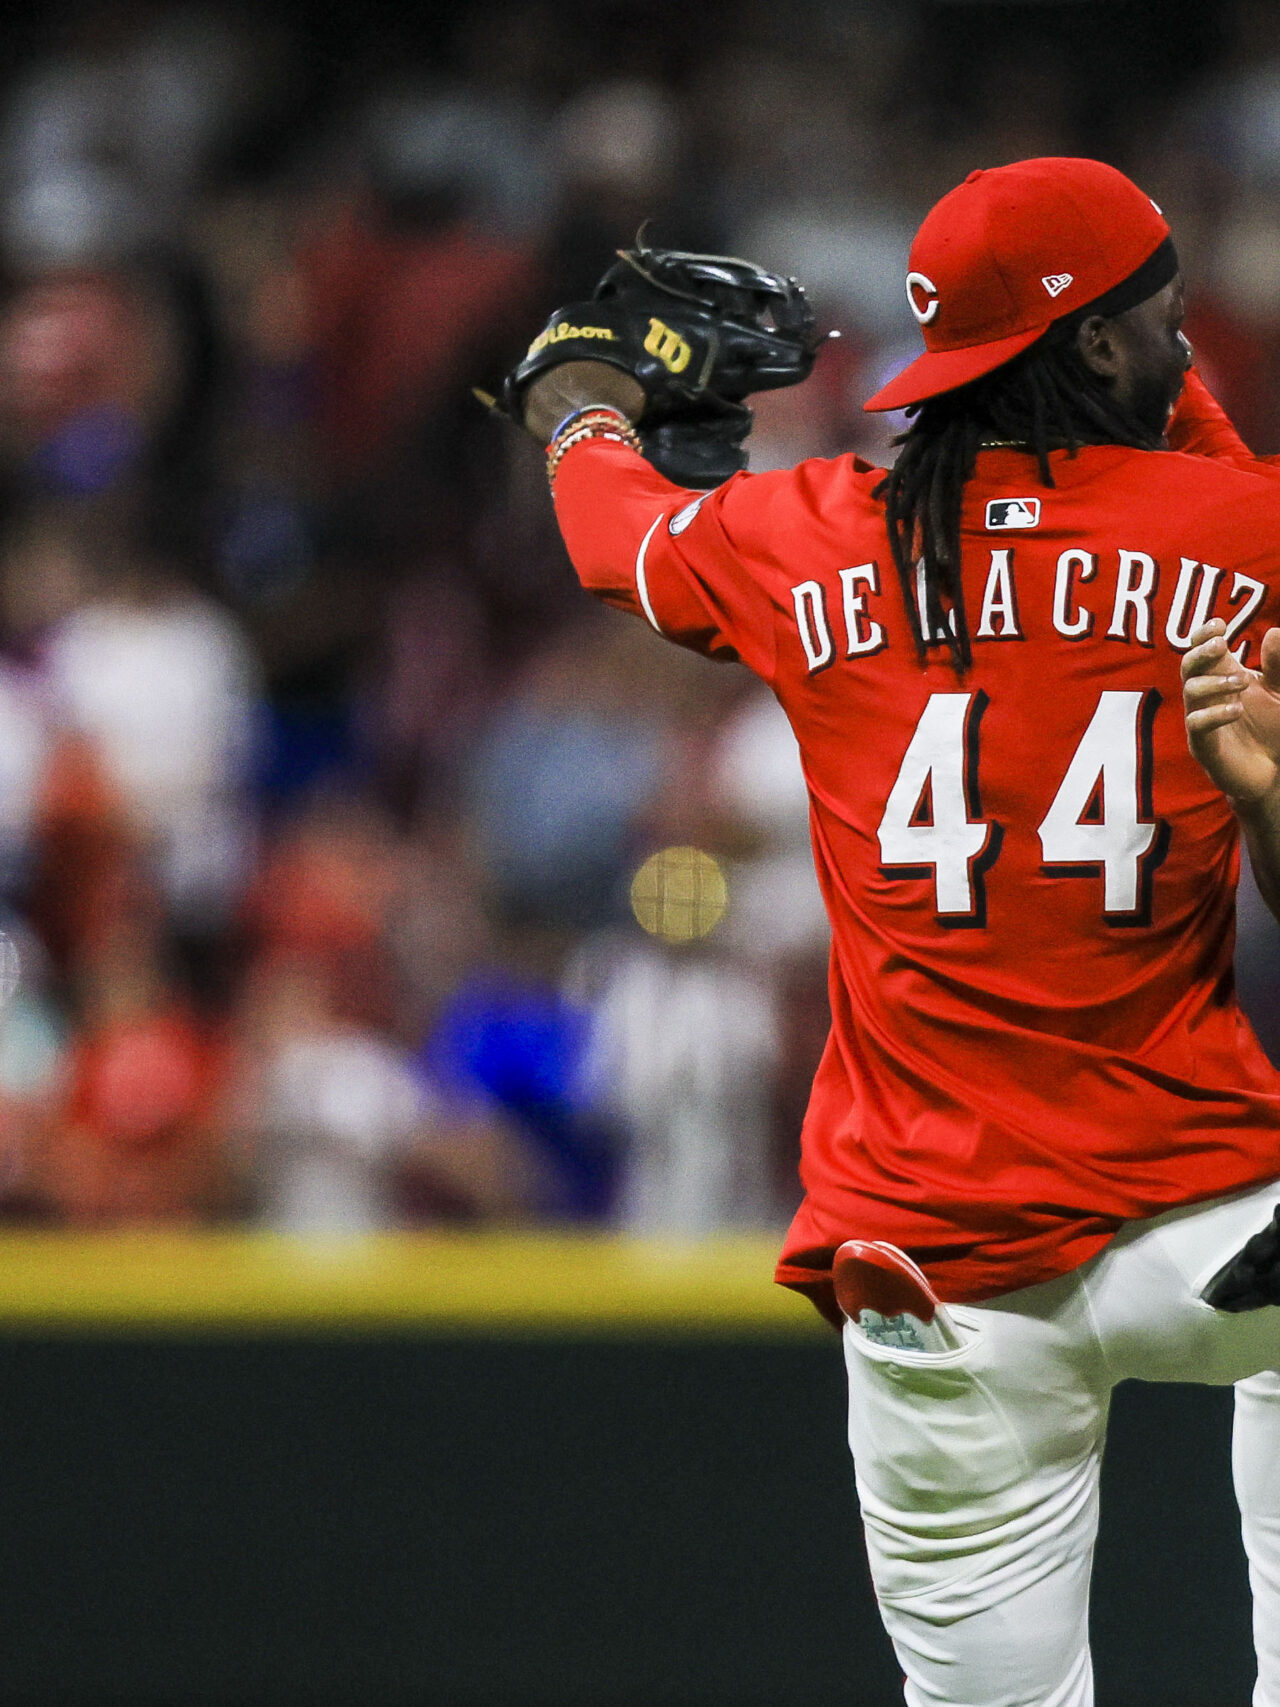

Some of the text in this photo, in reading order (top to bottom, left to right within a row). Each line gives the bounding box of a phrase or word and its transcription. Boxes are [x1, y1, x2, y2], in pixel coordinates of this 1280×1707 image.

[906, 271, 940, 325] C
[791, 561, 887, 673] DE
[1051, 547, 1269, 668] CRUZ
[876, 688, 1172, 928] 44
